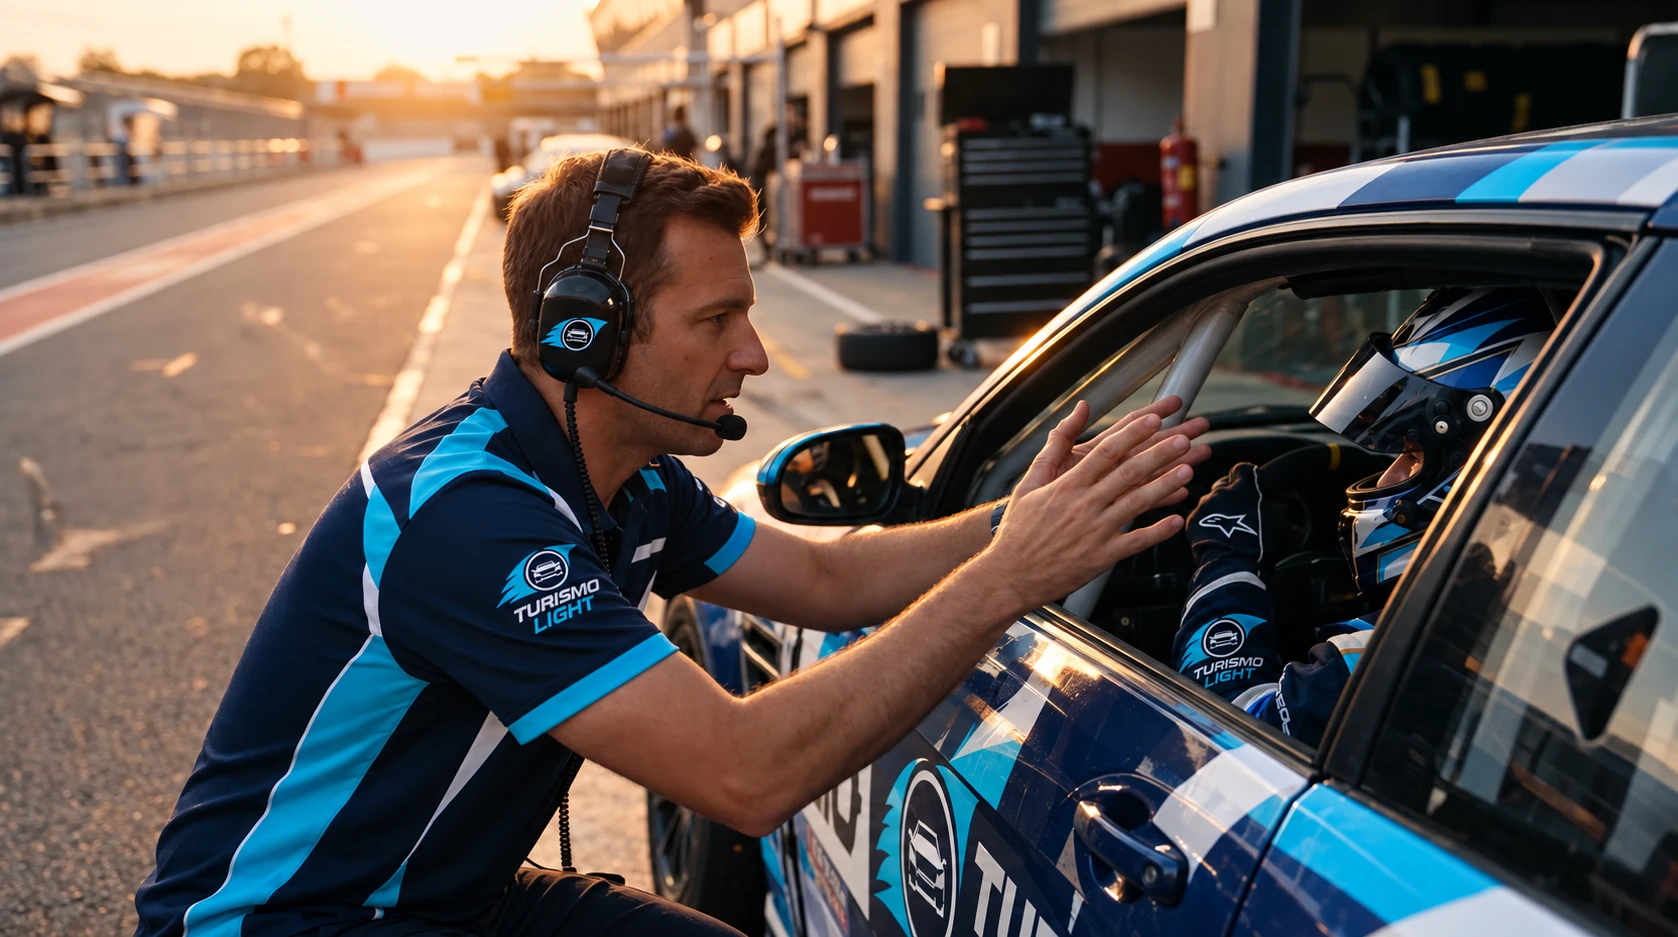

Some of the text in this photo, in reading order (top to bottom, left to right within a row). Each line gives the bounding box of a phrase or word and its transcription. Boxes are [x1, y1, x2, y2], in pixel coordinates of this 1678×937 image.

[513, 578, 600, 623] TURISMO
[533, 594, 595, 634] LIGHT
[1194, 657, 1264, 680] TURISMO
[1204, 667, 1256, 688] LIGHT
